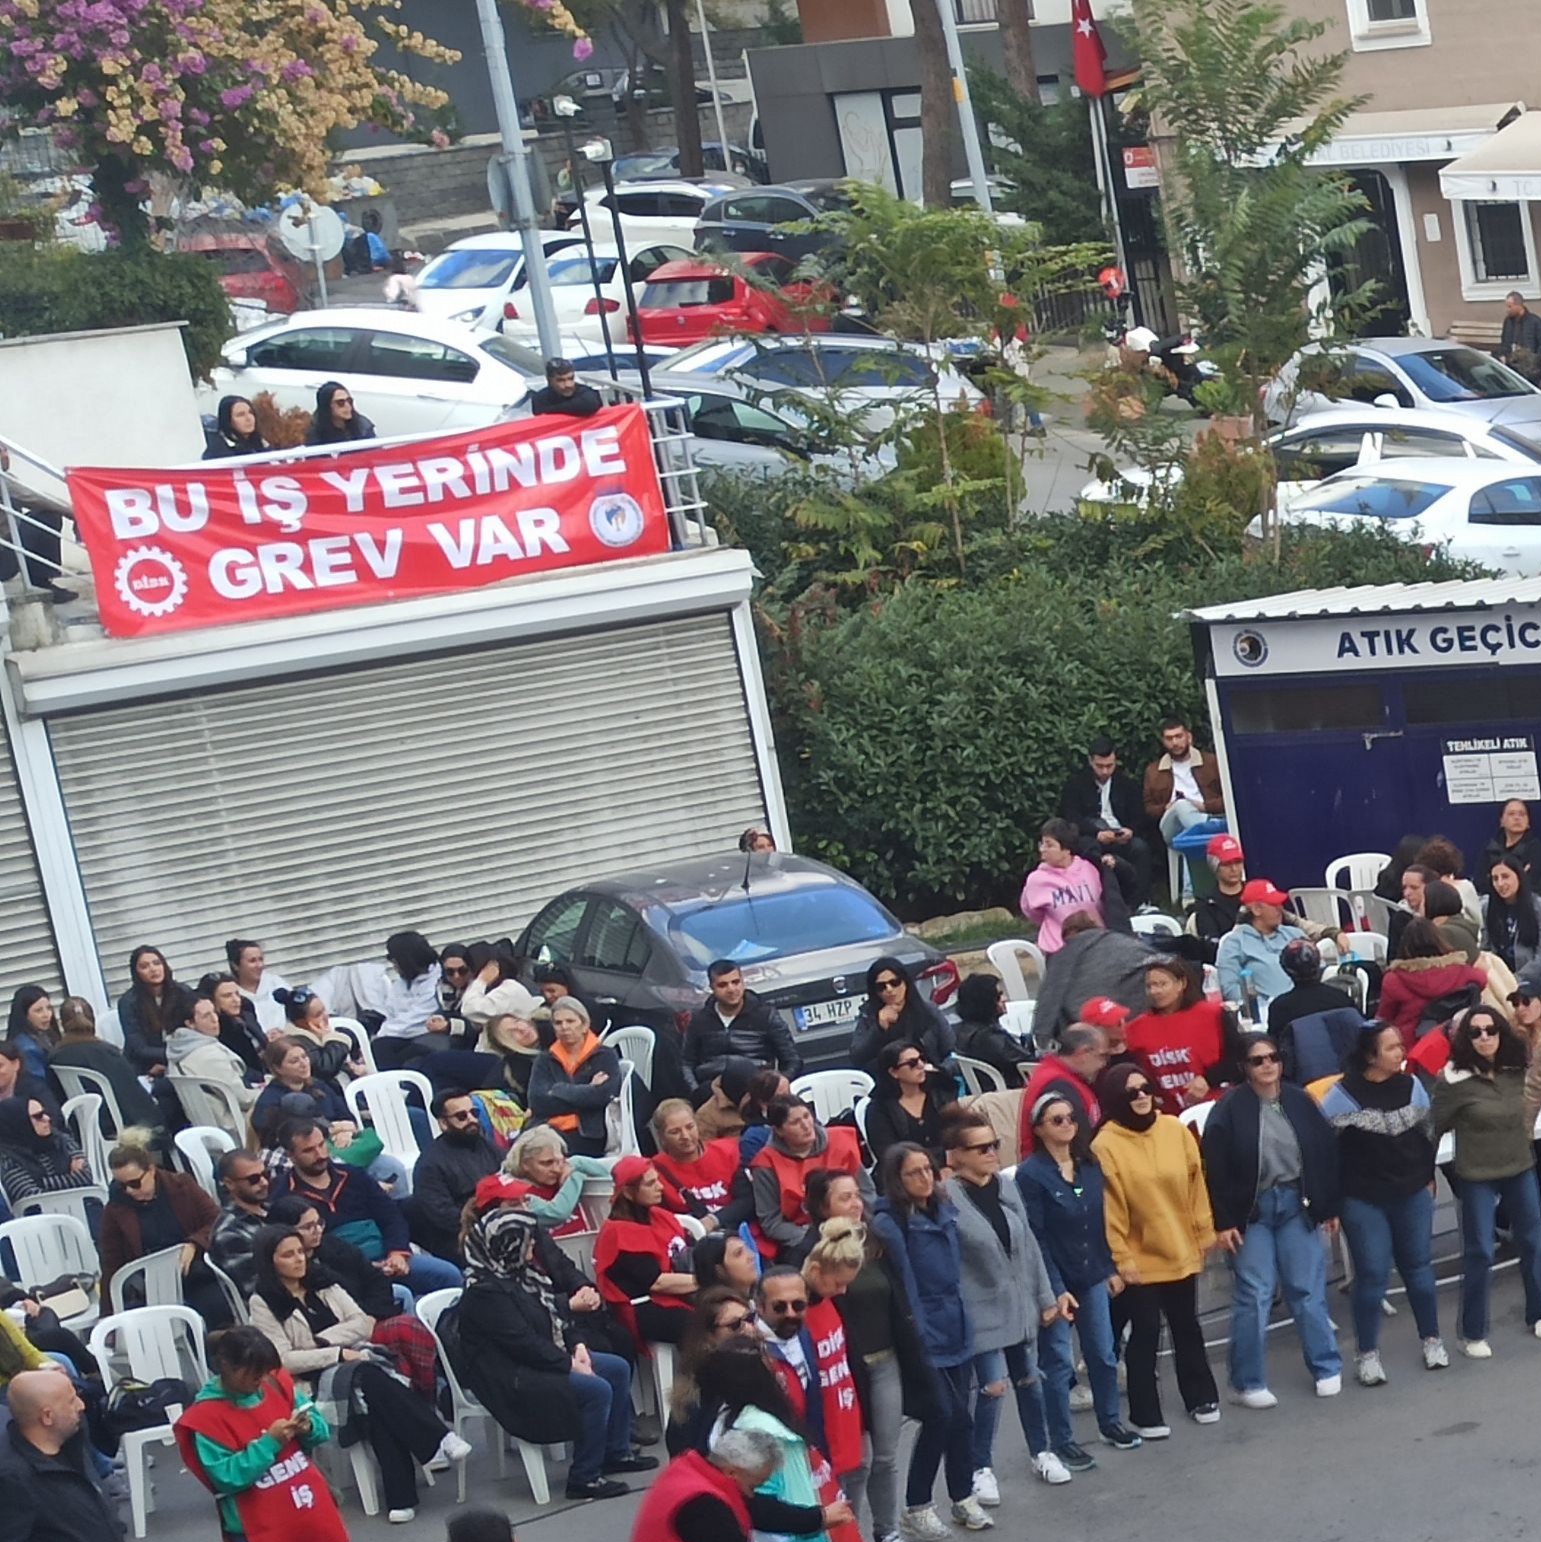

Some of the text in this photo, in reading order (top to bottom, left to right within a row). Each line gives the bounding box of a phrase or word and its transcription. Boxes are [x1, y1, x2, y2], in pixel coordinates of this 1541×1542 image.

[104, 426, 628, 541] BU İŞ YERİNDE
[208, 529, 402, 600] GREV
[427, 507, 571, 569] VAR
[1337, 627, 1421, 659] ATIK
[1503, 738, 1529, 749] ATIK
[804, 1000, 852, 1024] 34 HZP
[290, 1484, 314, 1510] İŞ
